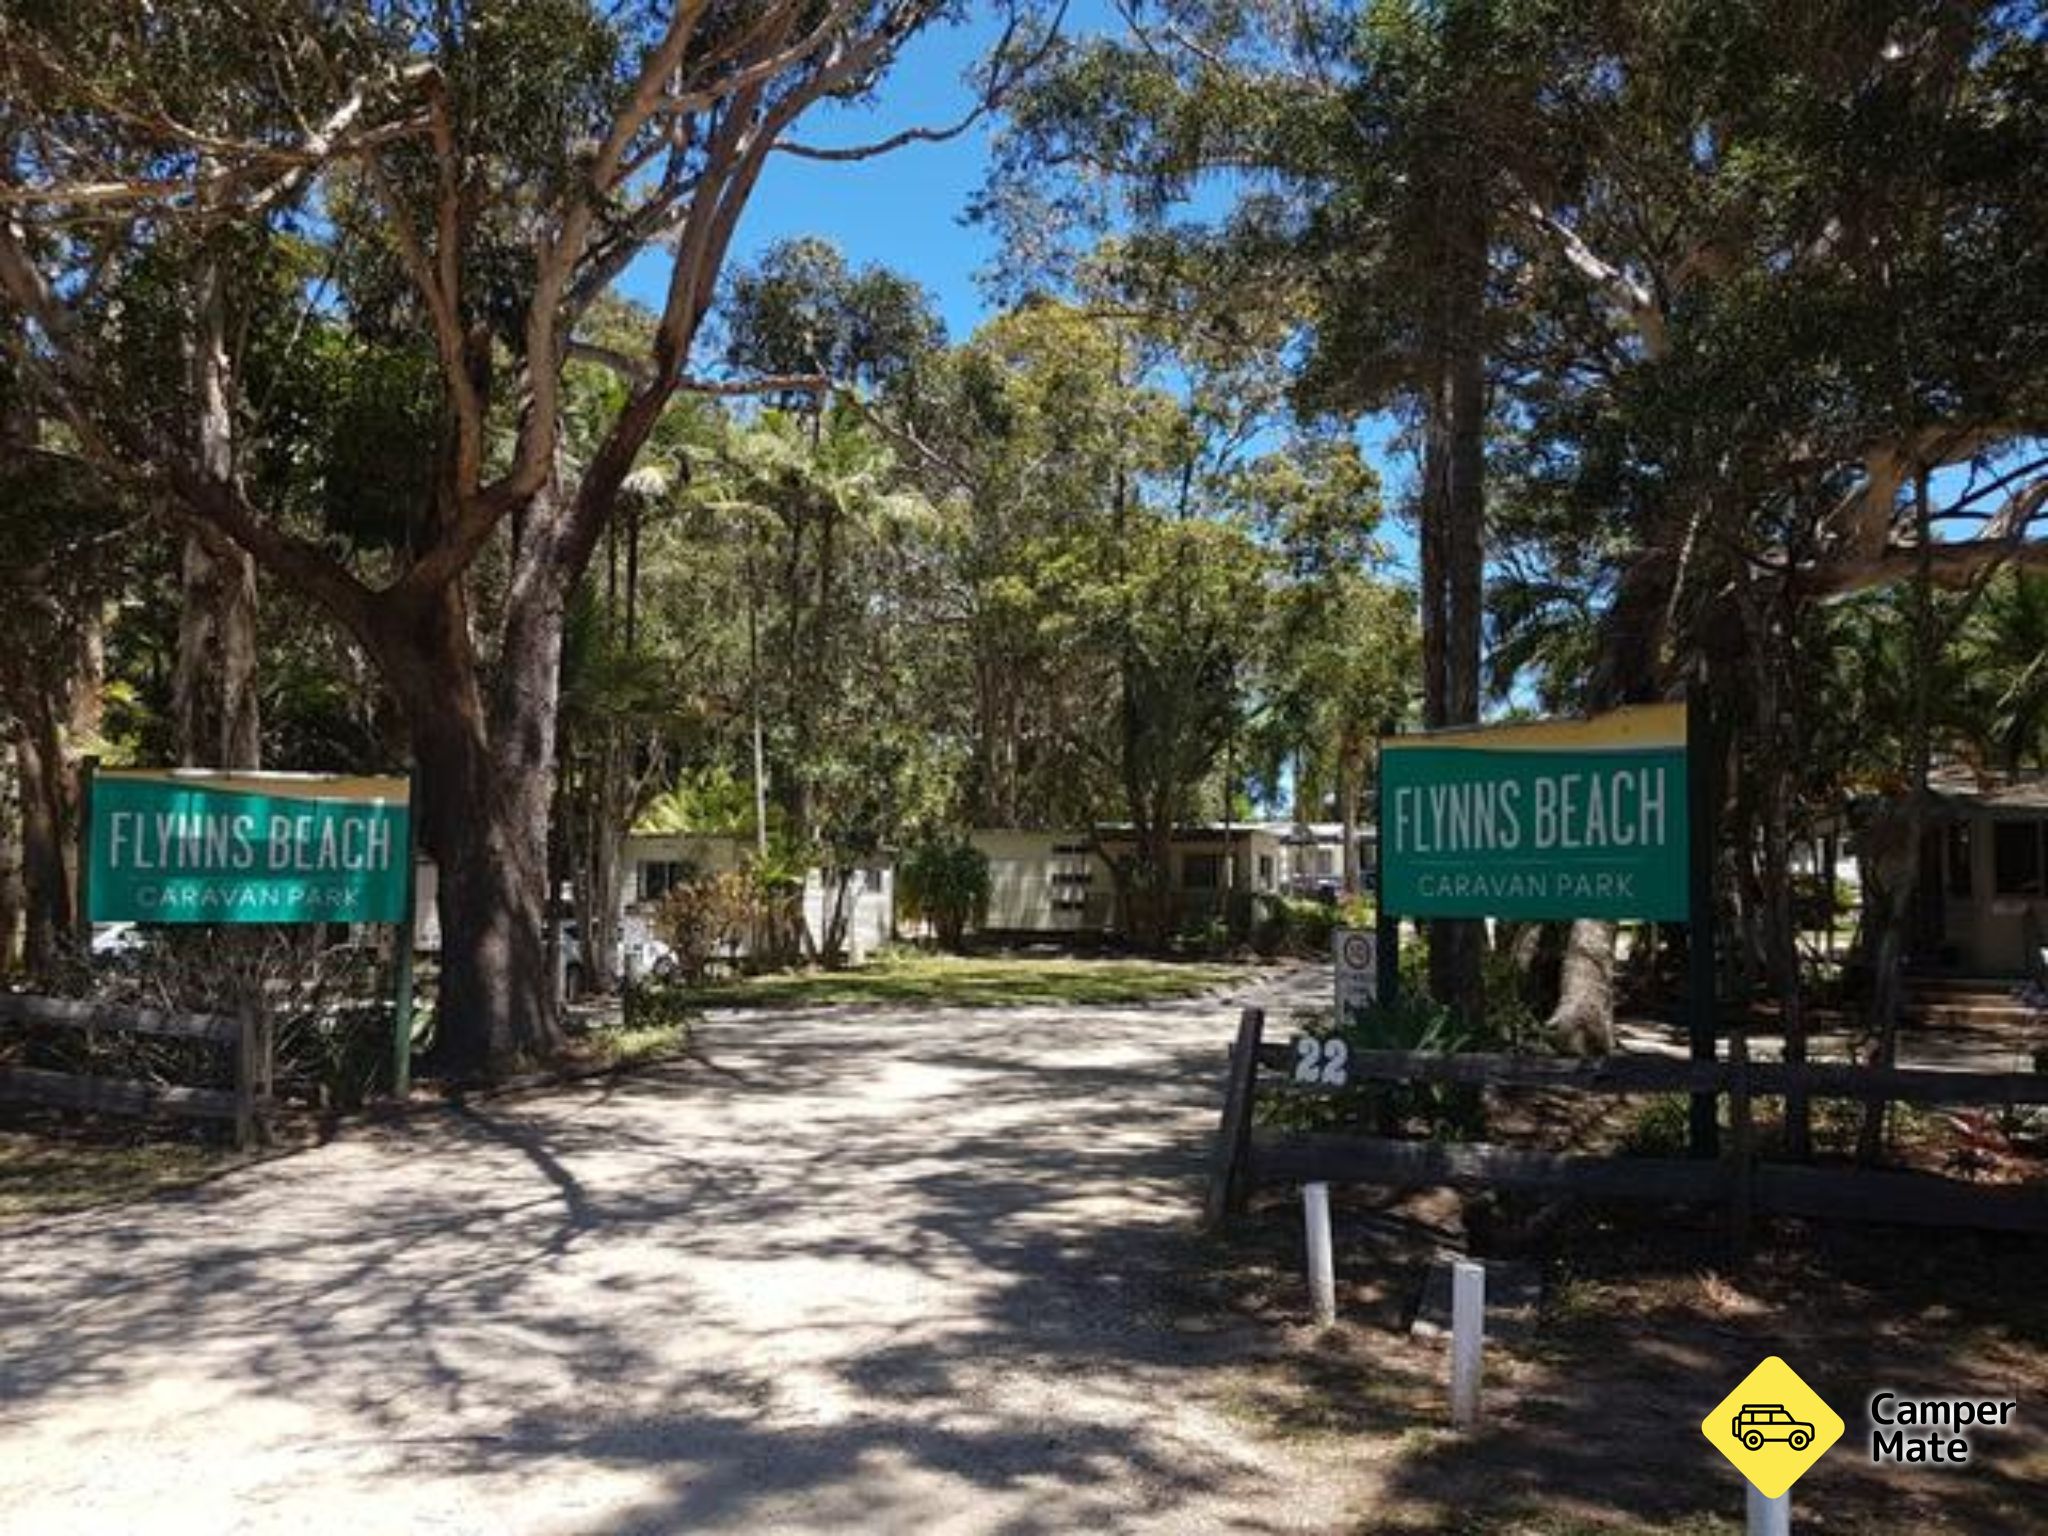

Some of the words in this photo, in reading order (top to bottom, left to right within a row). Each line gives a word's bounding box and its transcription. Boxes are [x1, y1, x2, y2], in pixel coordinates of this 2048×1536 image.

[1395, 780, 1521, 852] FLYNNS
[1535, 767, 1665, 848] BEACH
[111, 812, 254, 869] FLYNNS
[268, 815, 391, 871] BEACH
[138, 886, 279, 907] CARAVAN
[287, 886, 358, 907] PARK
[1418, 873, 1546, 897] CARAVAN
[1557, 873, 1634, 897] PARK
[1296, 1037, 1347, 1085] 22
